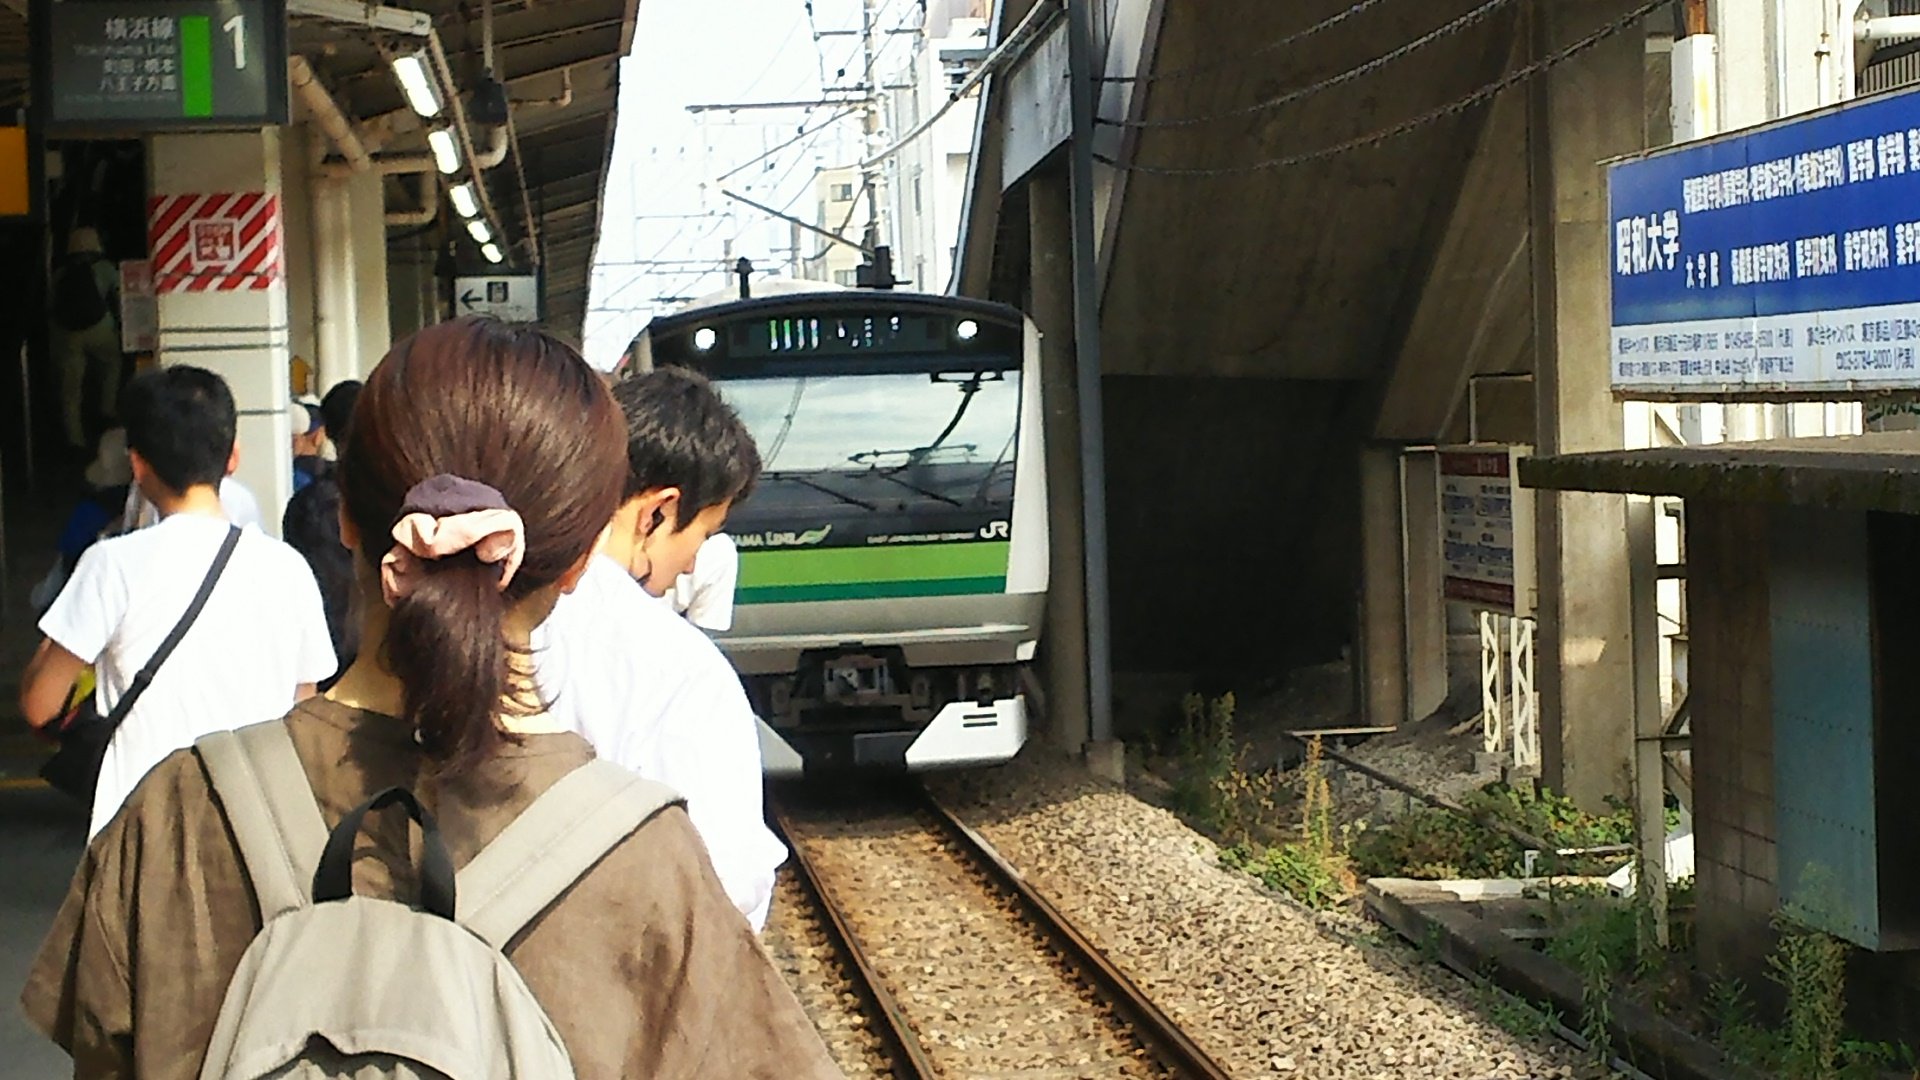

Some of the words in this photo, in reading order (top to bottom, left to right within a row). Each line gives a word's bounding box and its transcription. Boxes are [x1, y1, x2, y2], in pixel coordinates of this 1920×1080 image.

[104, 16, 174, 40] 横浜線
[223, 14, 246, 70] 1
[1616, 209, 1680, 276] 昭和大学
[980, 521, 1008, 539] JR
